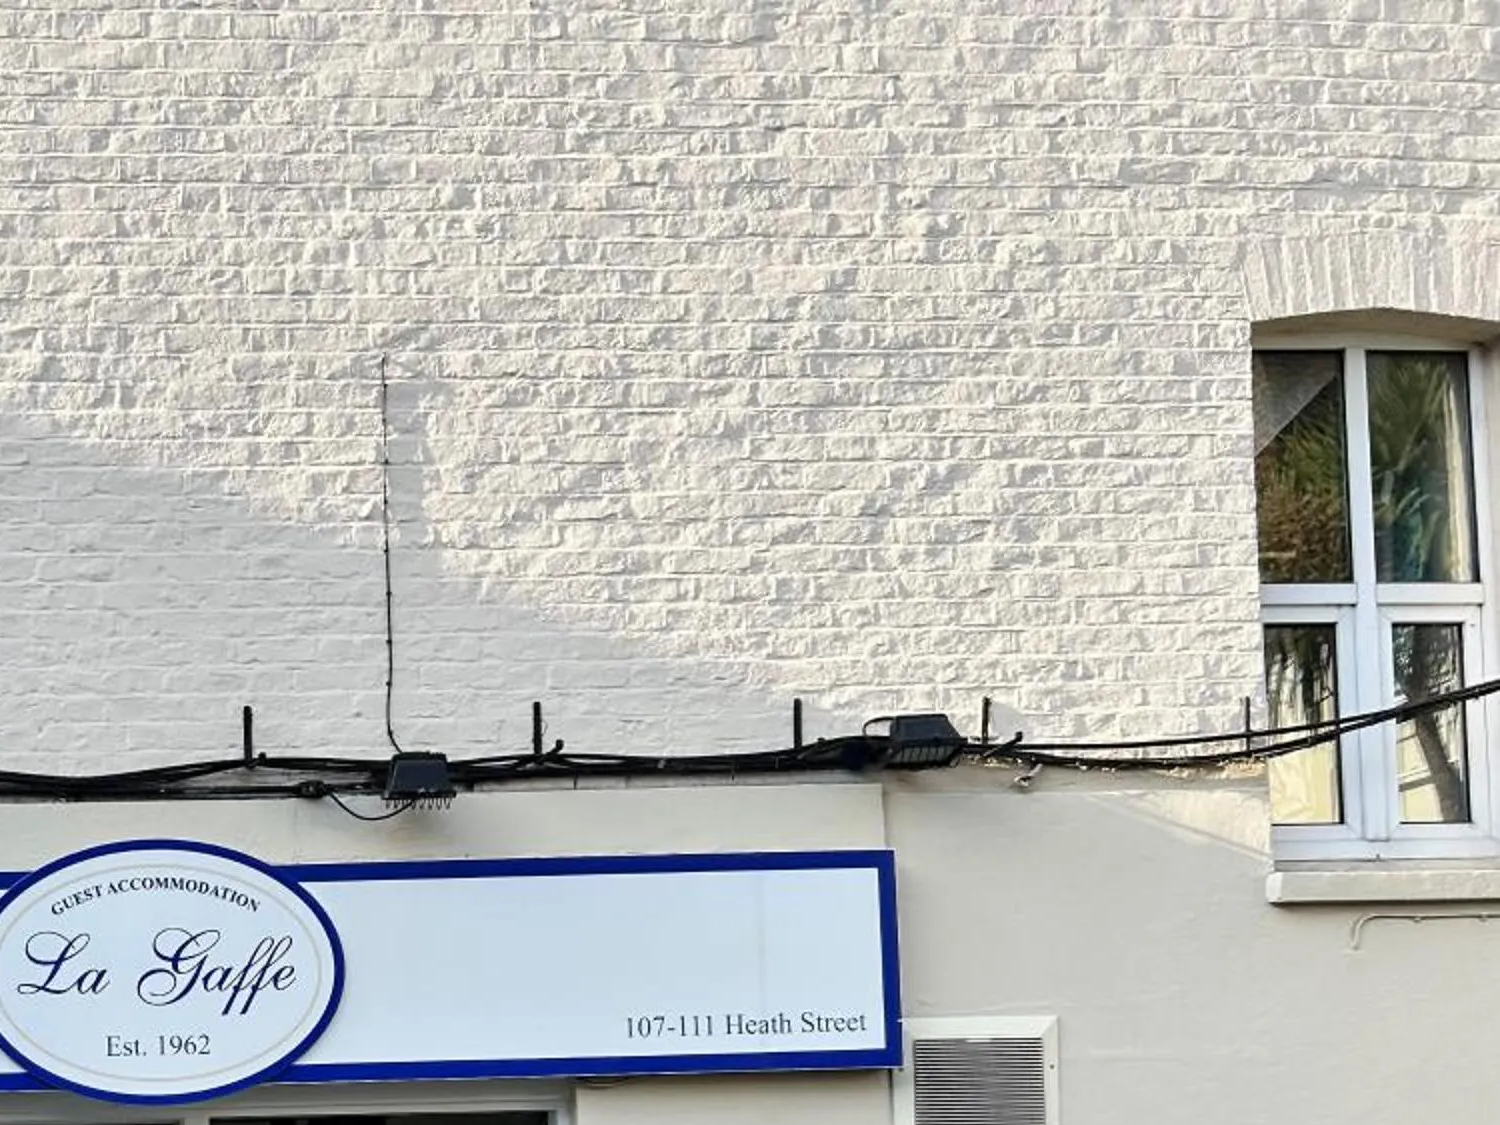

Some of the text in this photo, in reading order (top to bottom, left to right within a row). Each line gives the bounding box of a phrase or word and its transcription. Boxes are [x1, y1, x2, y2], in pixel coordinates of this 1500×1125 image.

[51, 876, 261, 916] GUEST ACCOMMODATION
[17, 926, 297, 1017] La Gaffe
[626, 1010, 867, 1038] 107-111 Heath Street
[105, 1034, 212, 1058] Est. 1962
